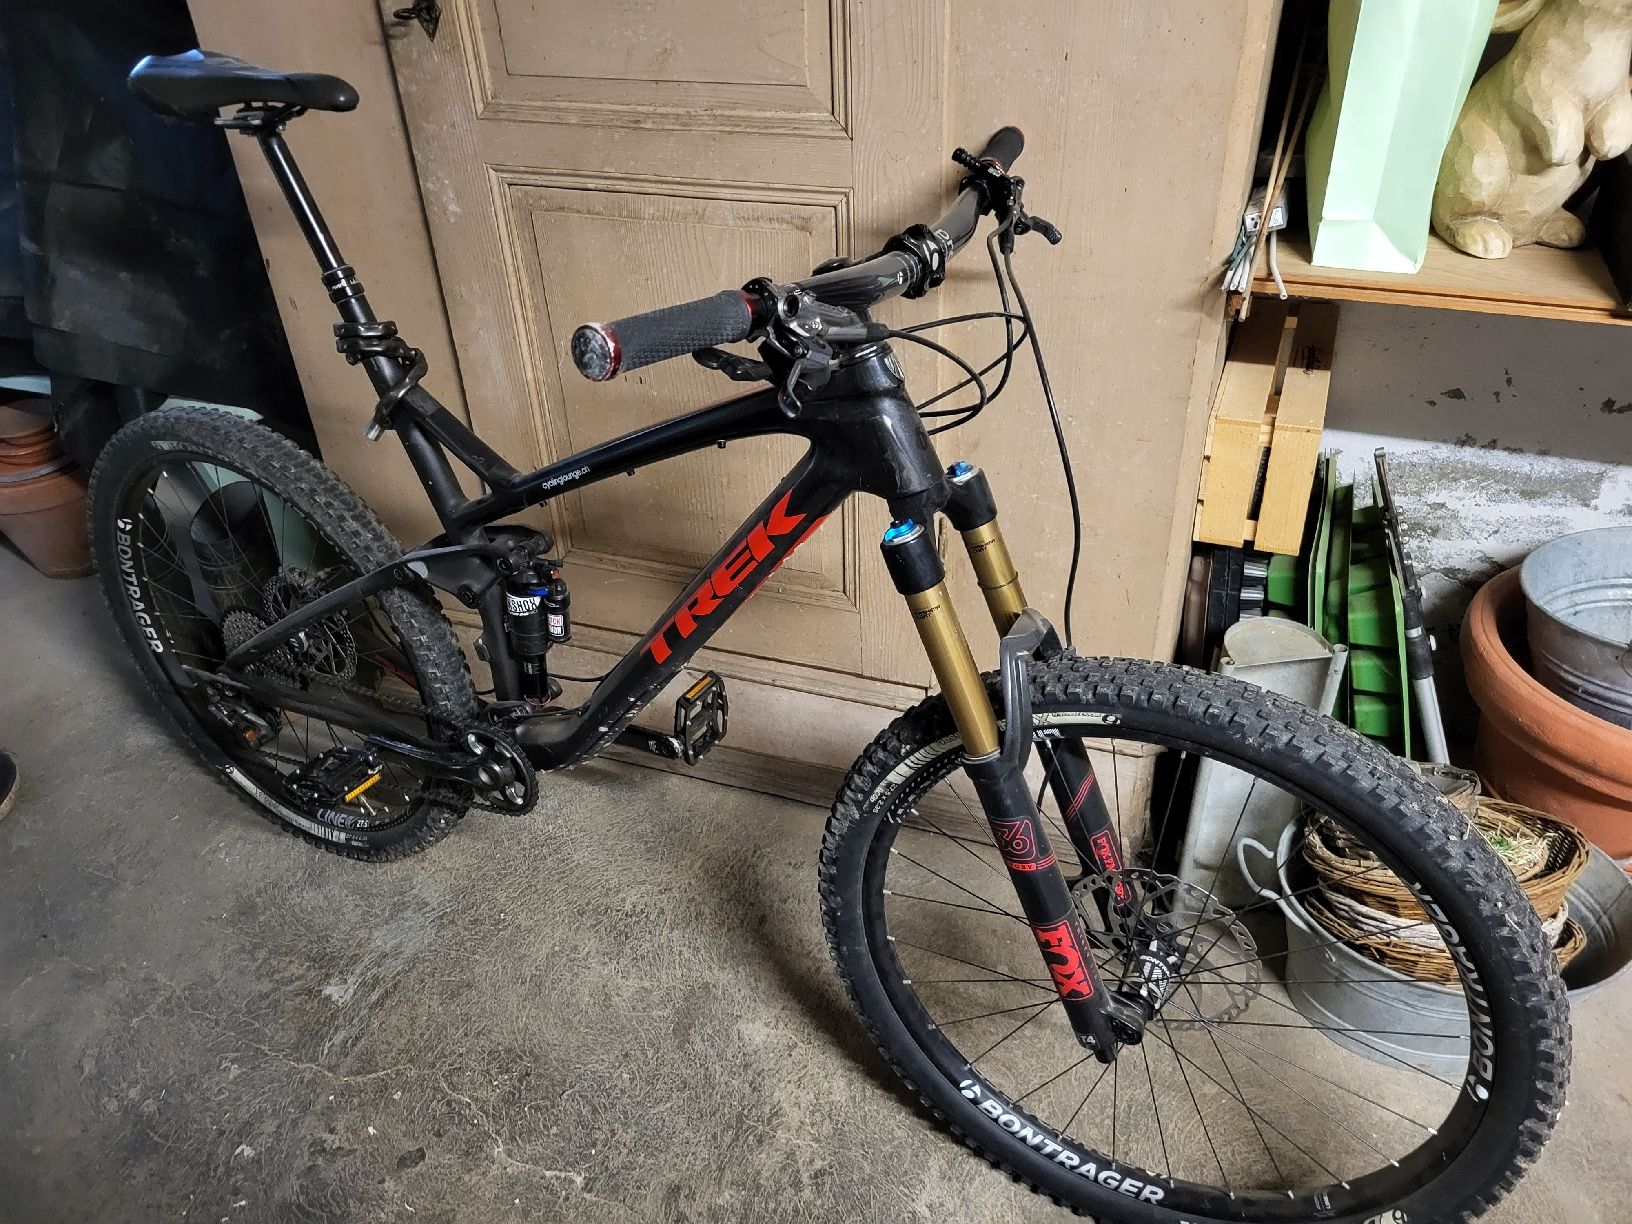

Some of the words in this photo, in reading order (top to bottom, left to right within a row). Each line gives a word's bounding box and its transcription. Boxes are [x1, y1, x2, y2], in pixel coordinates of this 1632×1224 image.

[117, 533, 164, 653] BONTRAGER
[639, 487, 808, 665] TREK
[1035, 922, 1090, 1000] FOX
[977, 1098, 1166, 1206] BONTRAGER
